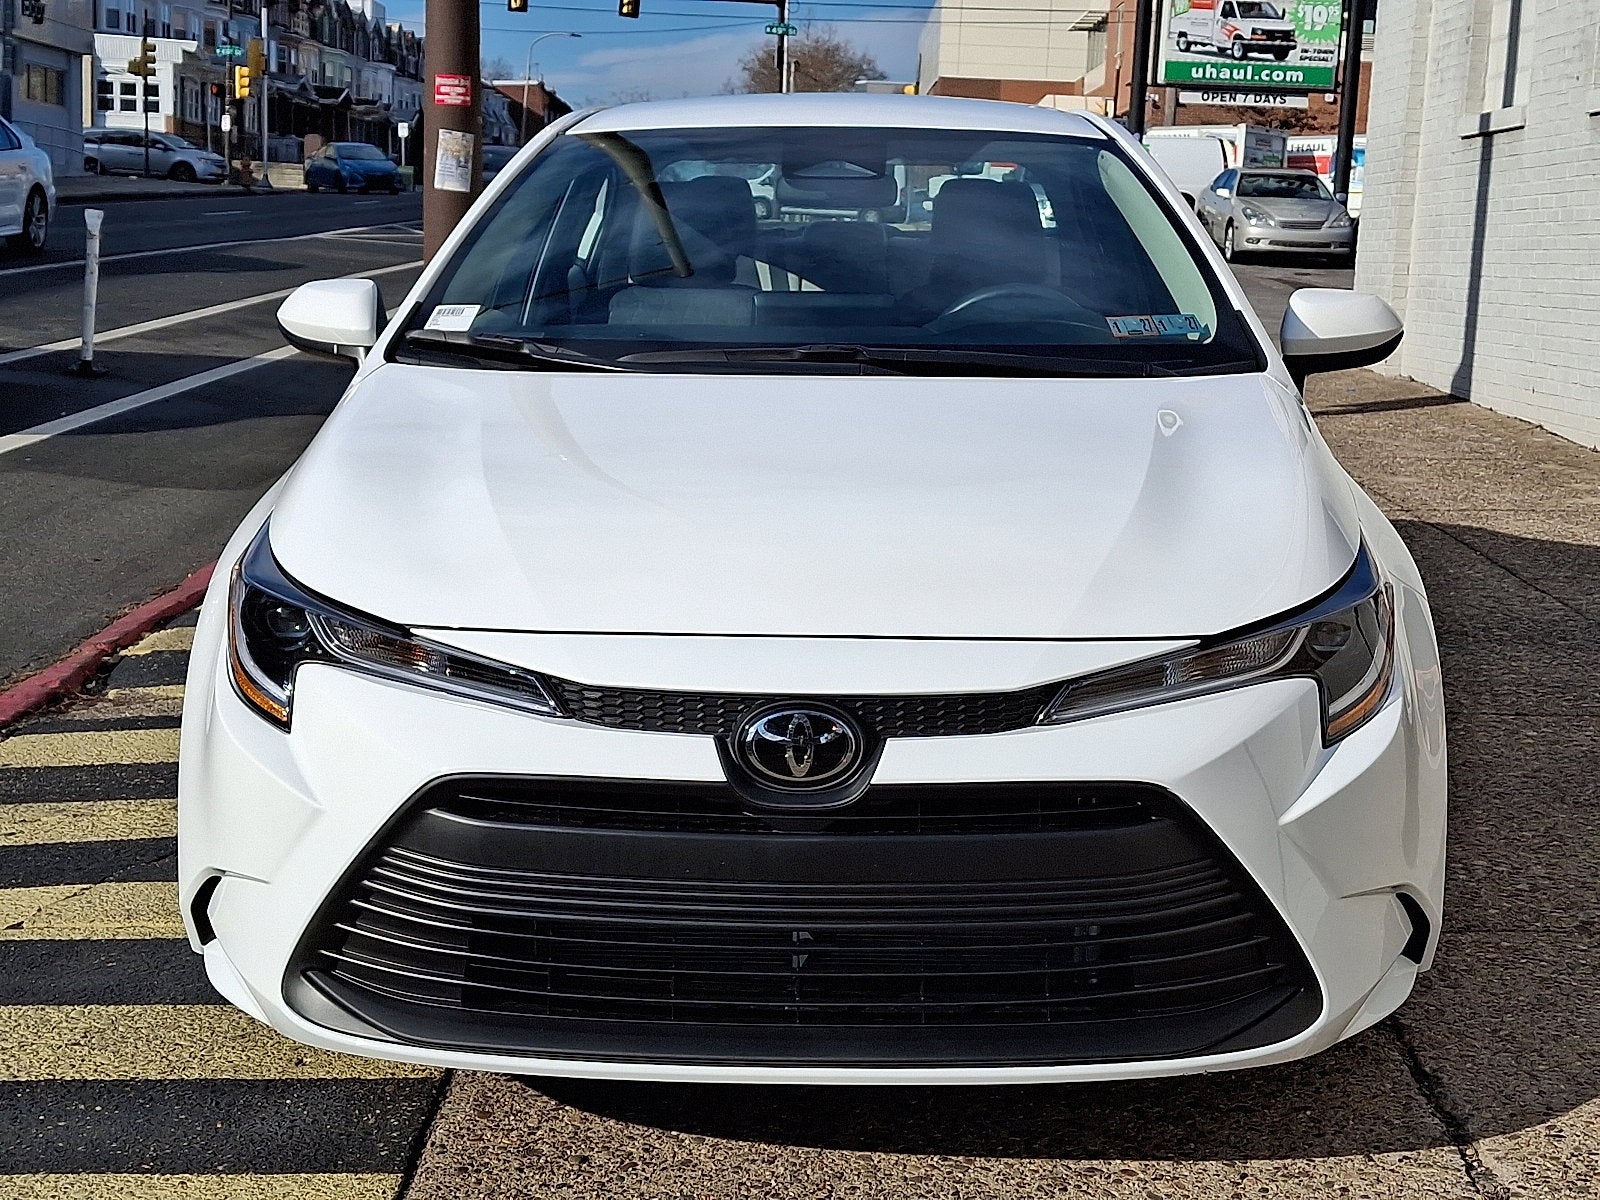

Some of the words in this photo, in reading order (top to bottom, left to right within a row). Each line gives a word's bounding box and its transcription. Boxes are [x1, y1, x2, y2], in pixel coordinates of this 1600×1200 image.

[1191, 63, 1304, 82] uhaul.com
[1201, 91, 1237, 103] OPEN
[1242, 93, 1249, 103] 7
[1253, 94, 1287, 105] DAYS
